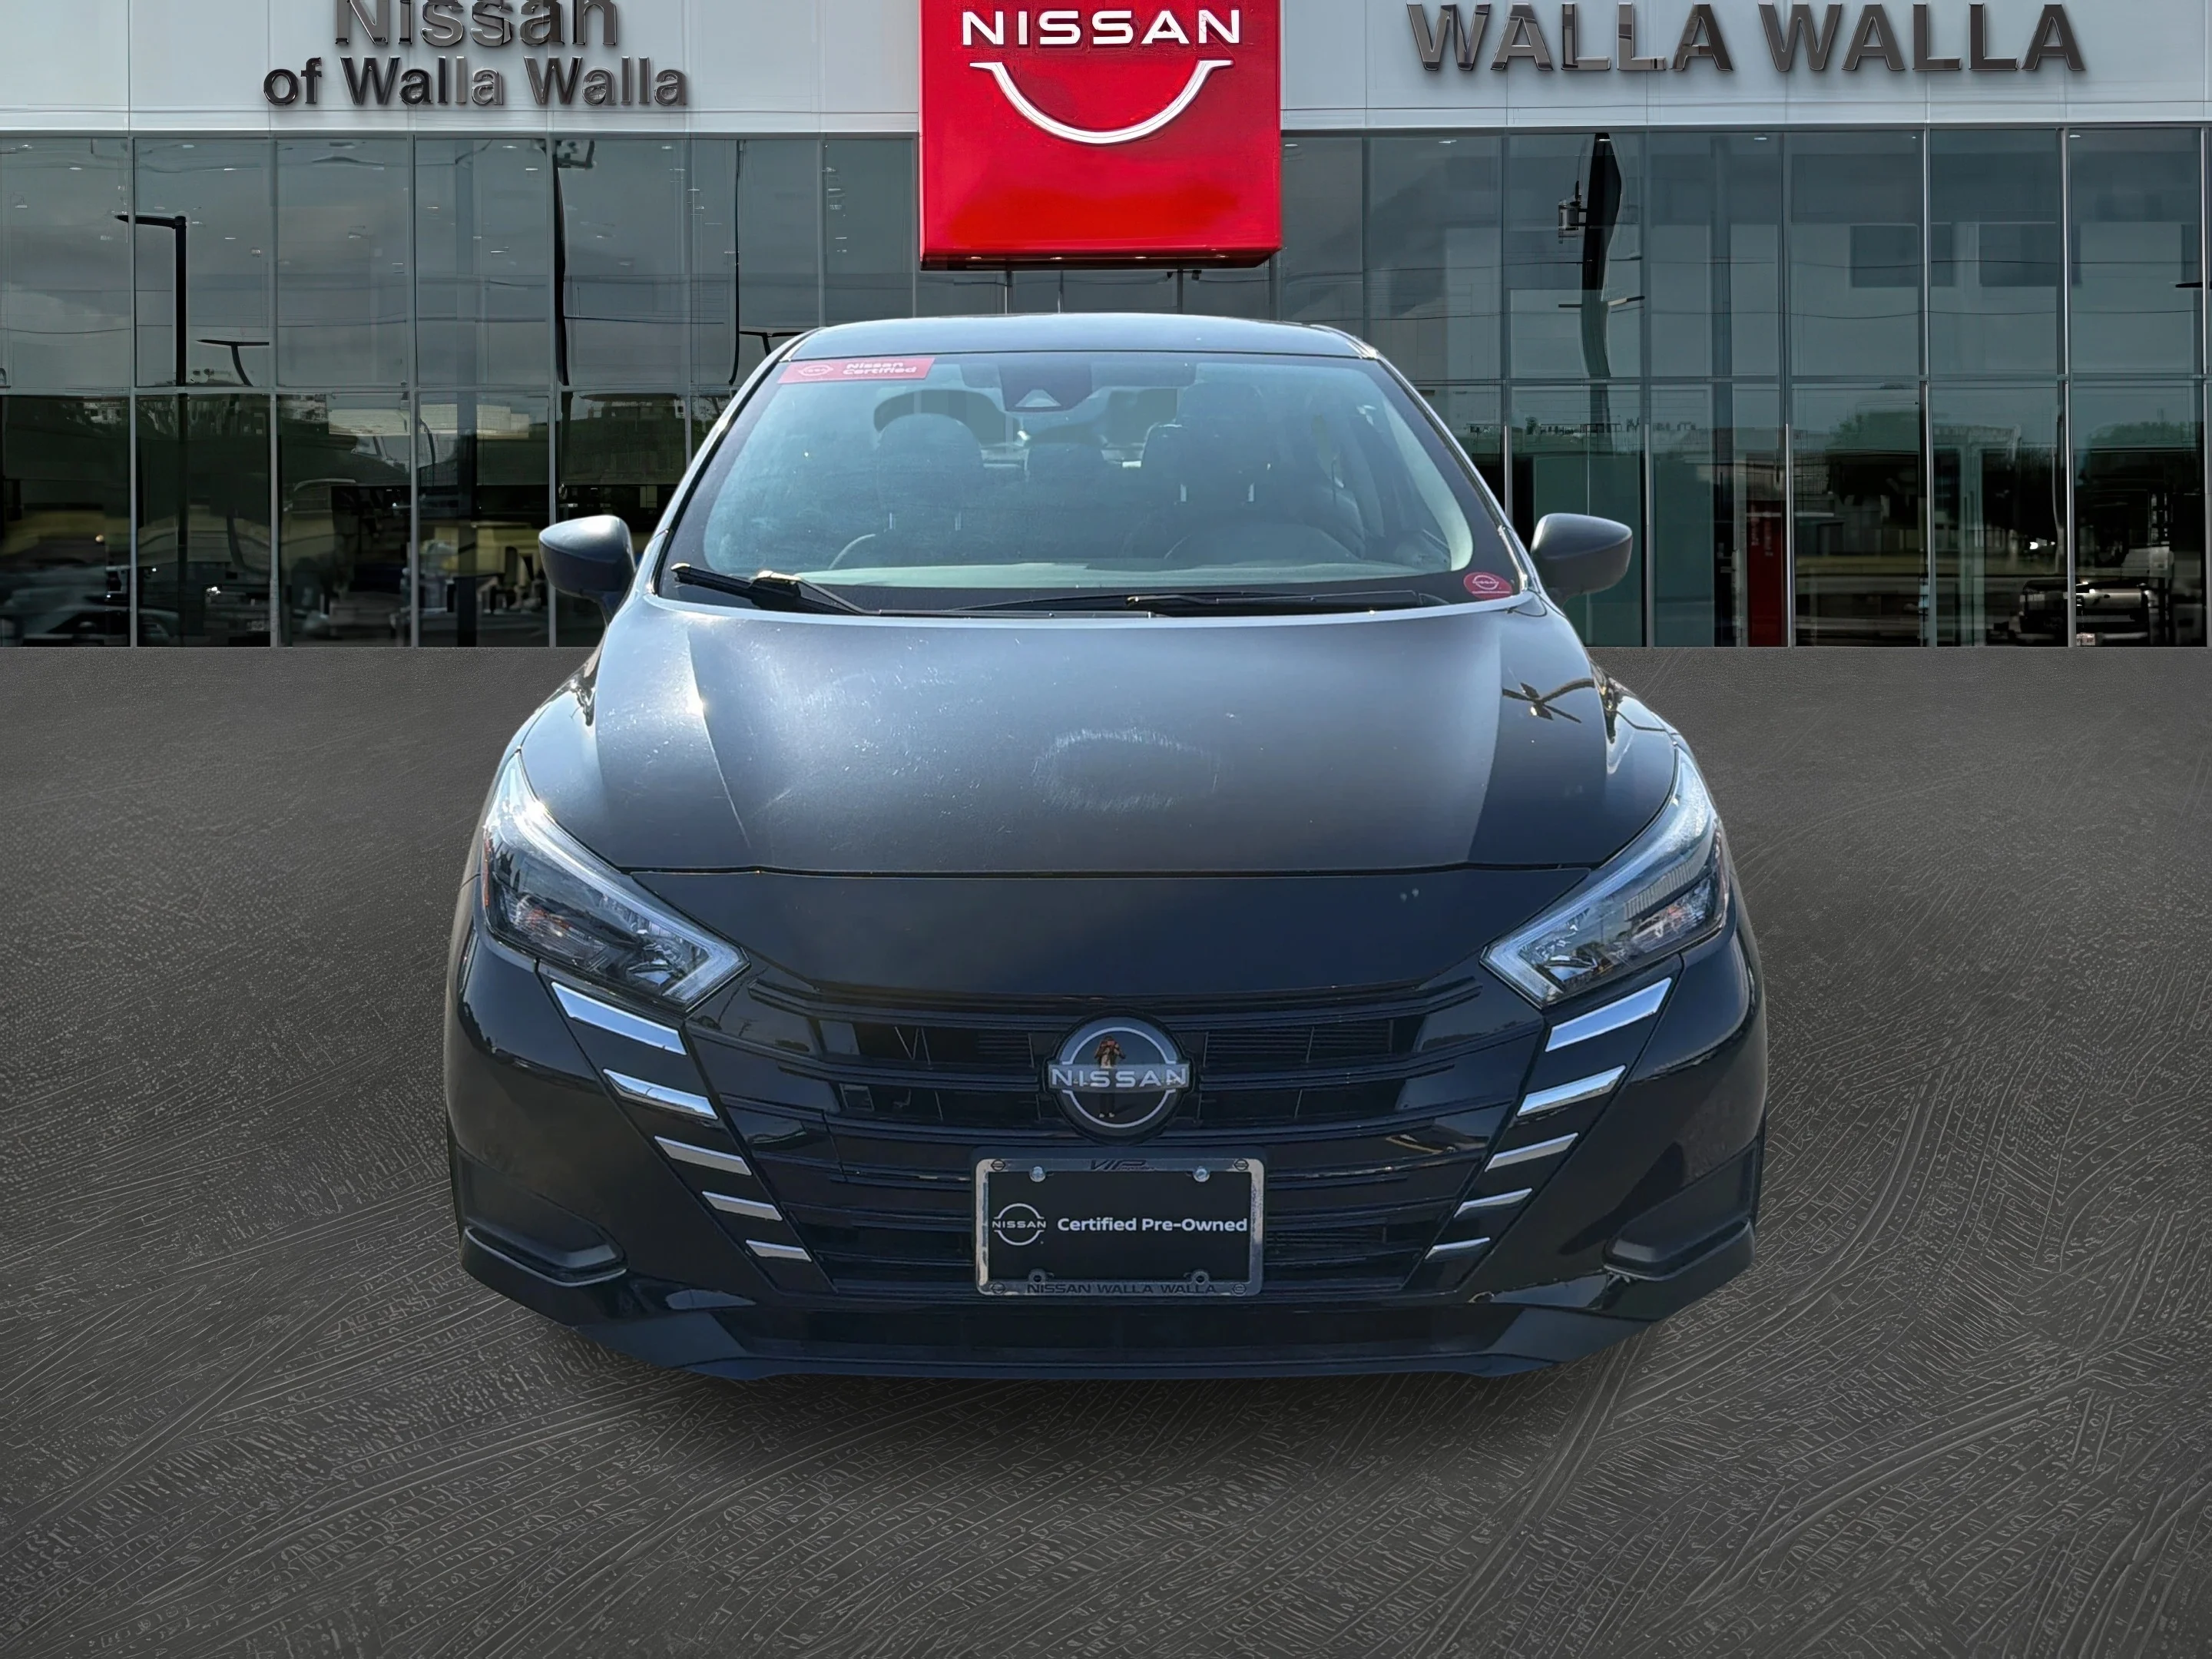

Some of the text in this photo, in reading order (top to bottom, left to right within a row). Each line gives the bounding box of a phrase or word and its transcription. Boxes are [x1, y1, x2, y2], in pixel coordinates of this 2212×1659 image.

[335, 0, 618, 47] Nissan
[962, 9, 1240, 46] NISSAN
[1406, 3, 2085, 71] WALLA WALLA
[263, 56, 687, 105] of Walla Walla
[843, 366, 917, 375] Certified
[1051, 1068, 1186, 1088] NISSAN
[992, 1220, 1046, 1229] NISSAN
[1058, 1217, 1247, 1232] Certified Pre-Owned
[1027, 1283, 1217, 1294] NISSAN WALLA WALLA
